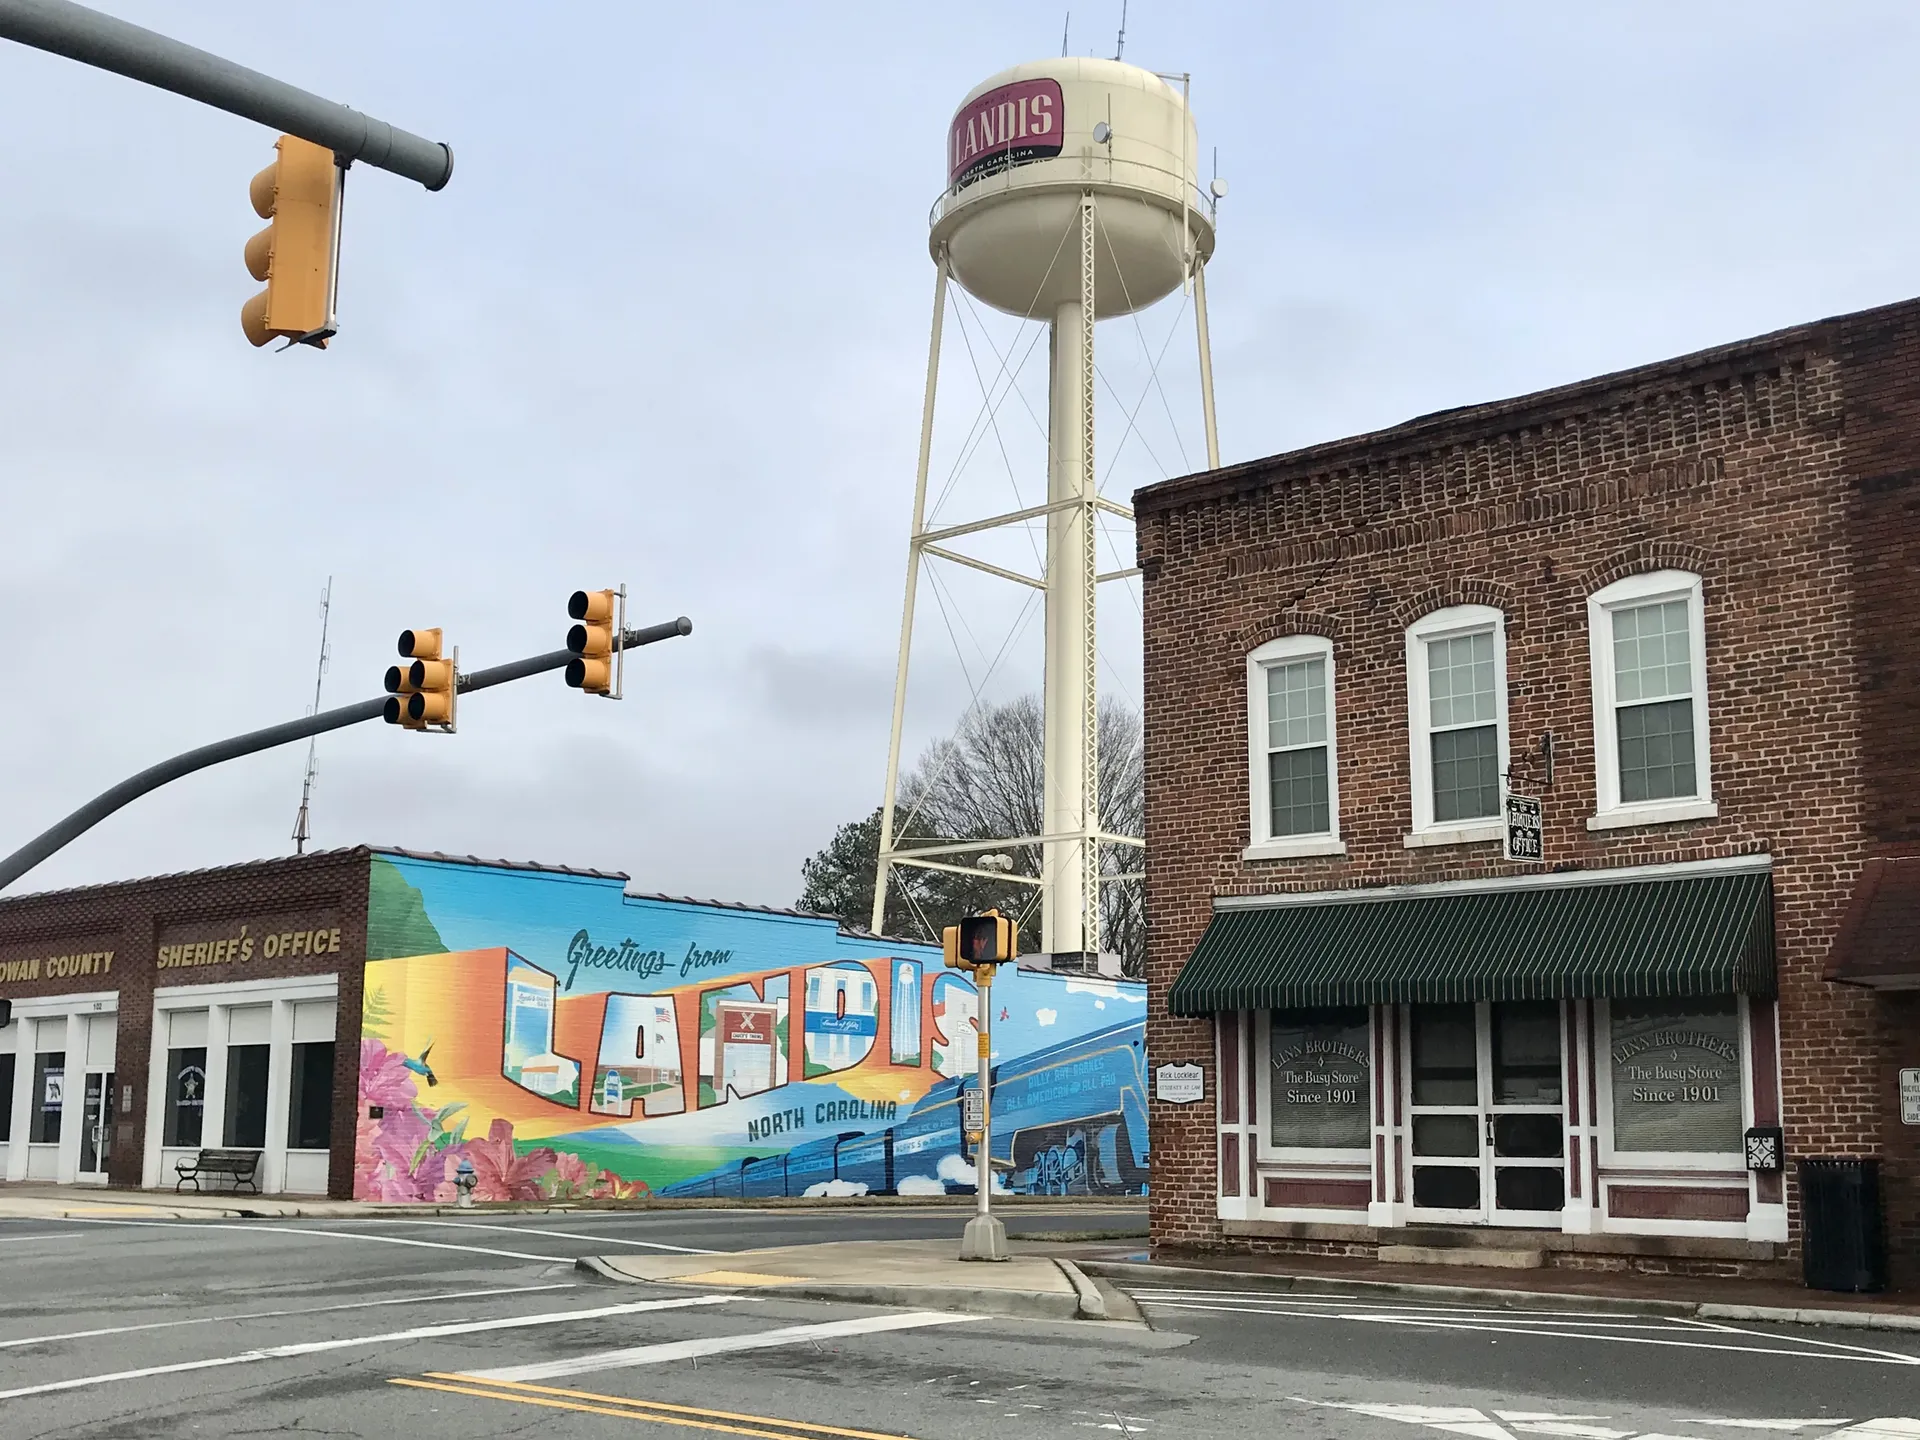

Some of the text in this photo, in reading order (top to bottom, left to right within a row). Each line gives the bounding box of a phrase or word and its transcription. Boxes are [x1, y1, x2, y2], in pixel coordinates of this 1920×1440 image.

[955, 94, 1053, 168] LANDIS
[961, 164, 984, 180] NORTH
[987, 149, 1034, 167] CAROLINA
[156, 925, 341, 969] SHERIFF'S OFFICE
[564, 928, 734, 992] Greetings from
[46, 951, 115, 979] COUNTY
[501, 946, 981, 1119] LANDIS
[1612, 1031, 1737, 1065] LINN BROTHERS
[1271, 1039, 1370, 1070] LINN BROTHERS
[1305, 1070, 1331, 1087] Busy
[1655, 1065, 1687, 1083] Busy
[1287, 1088, 1357, 1103] Since 1901
[1632, 1086, 1720, 1102] Since 1901
[747, 1101, 897, 1142] NORTH CAROLINA
